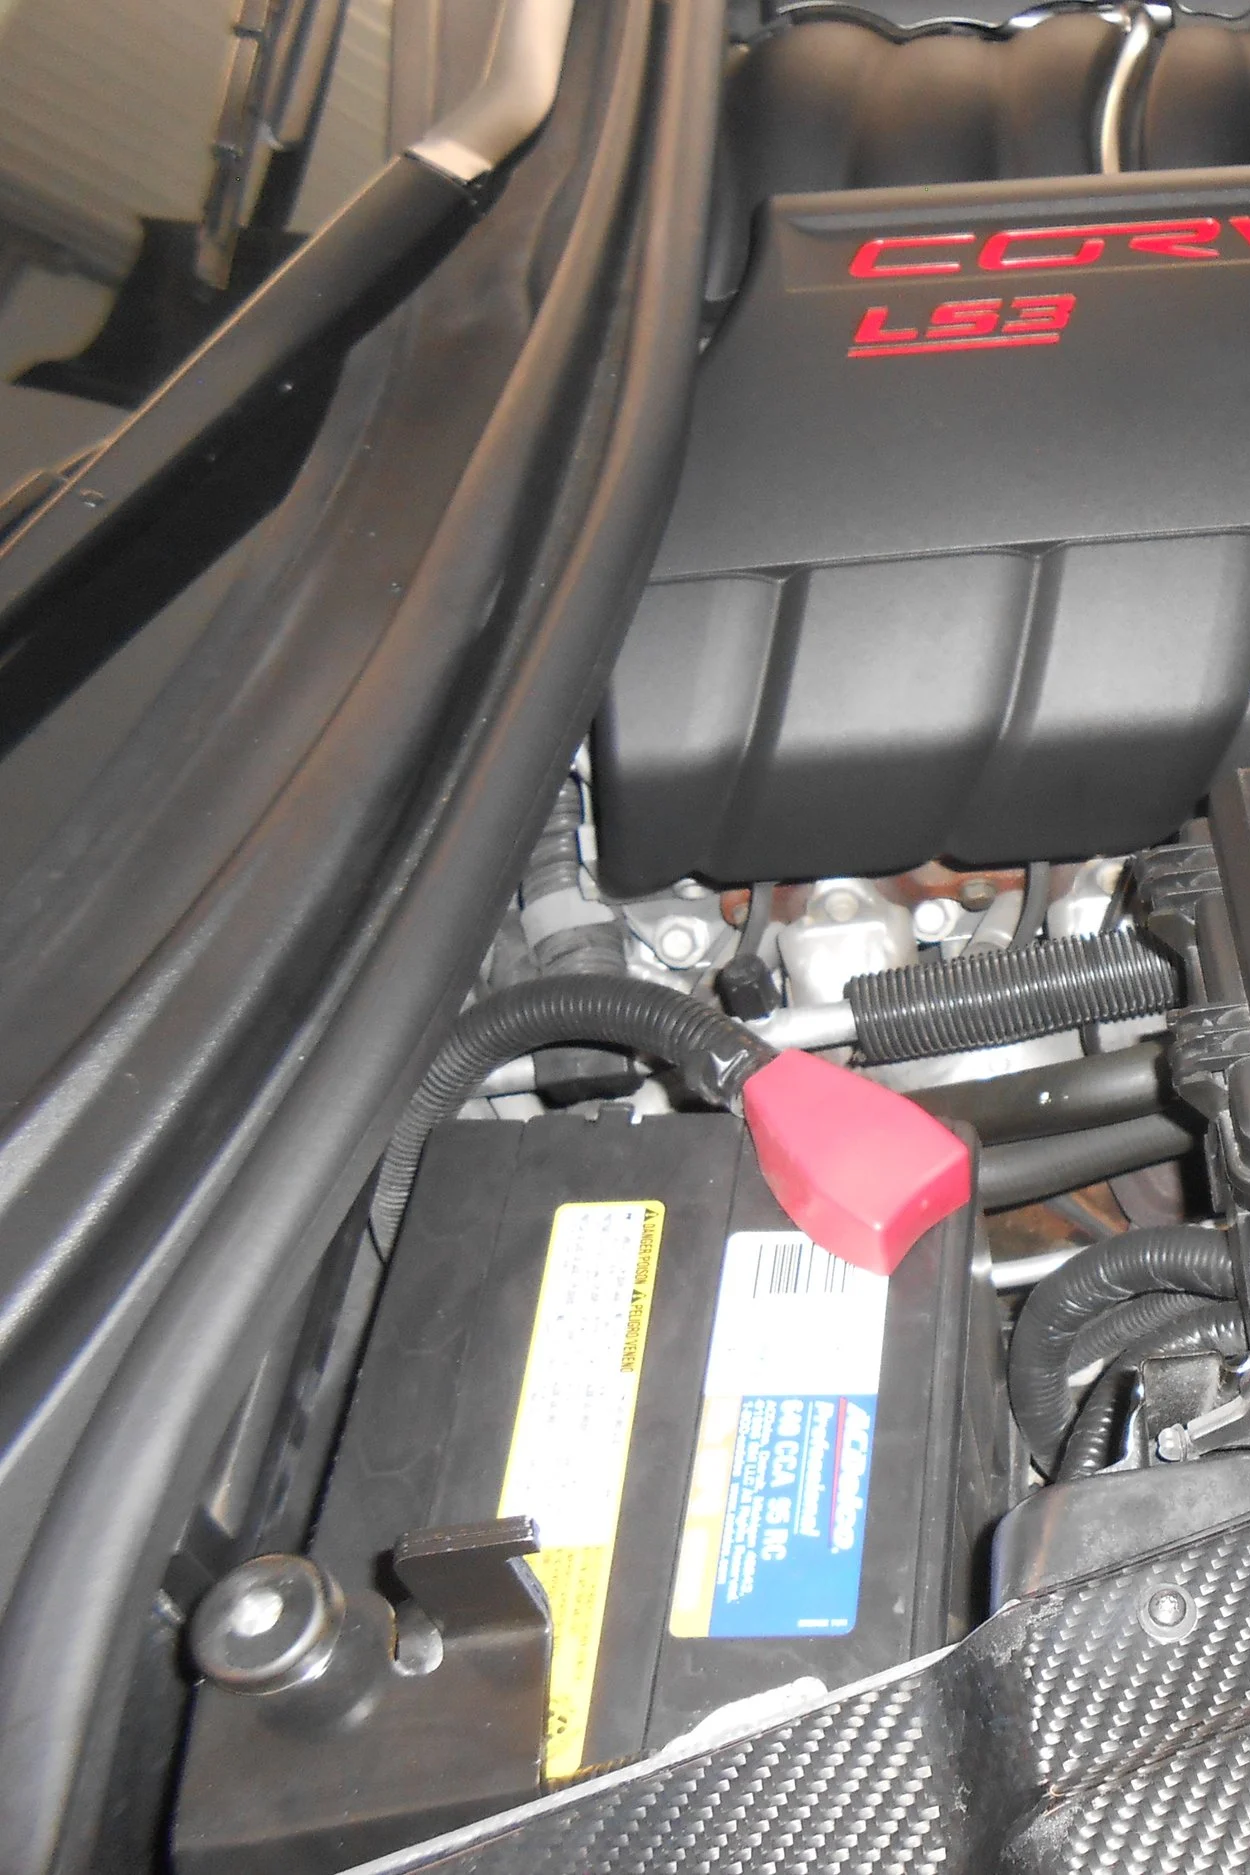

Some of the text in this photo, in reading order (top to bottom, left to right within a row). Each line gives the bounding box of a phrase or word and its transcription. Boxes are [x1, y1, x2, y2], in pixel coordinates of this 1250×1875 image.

[852, 292, 1077, 345] LS3
[770, 1440, 800, 1488] CCA
[799, 1400, 836, 1538] Professional
[832, 1402, 871, 1551] ACDelco
[761, 1528, 789, 1561] RC
